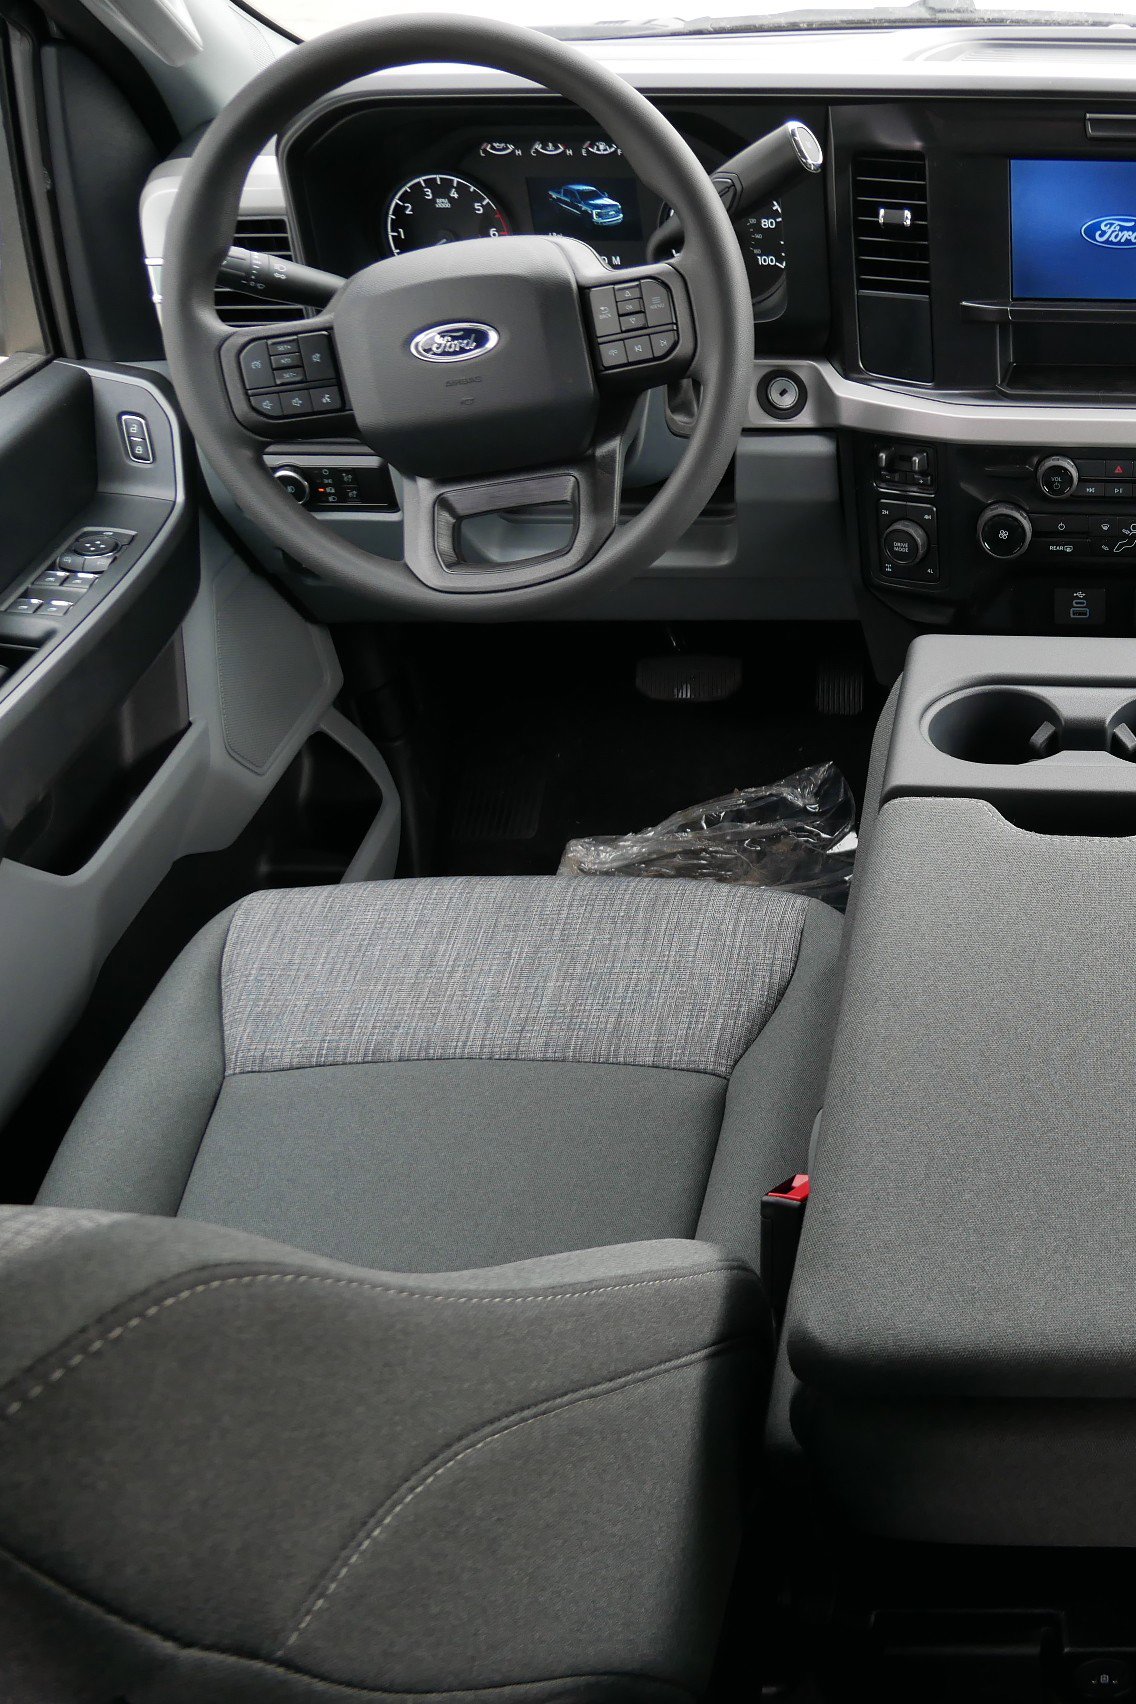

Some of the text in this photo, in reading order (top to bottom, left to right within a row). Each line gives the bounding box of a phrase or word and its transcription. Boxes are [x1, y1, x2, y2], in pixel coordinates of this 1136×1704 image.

[424, 188, 433, 199] 3
[450, 188, 459, 199] 4
[404, 203, 413, 214] 2
[474, 202, 483, 214] 5
[761, 218, 776, 229] 80
[398, 228, 405, 239] 1
[489, 228, 499, 238] 6
[757, 256, 776, 265] 100
[432, 331, 477, 354] Ford
